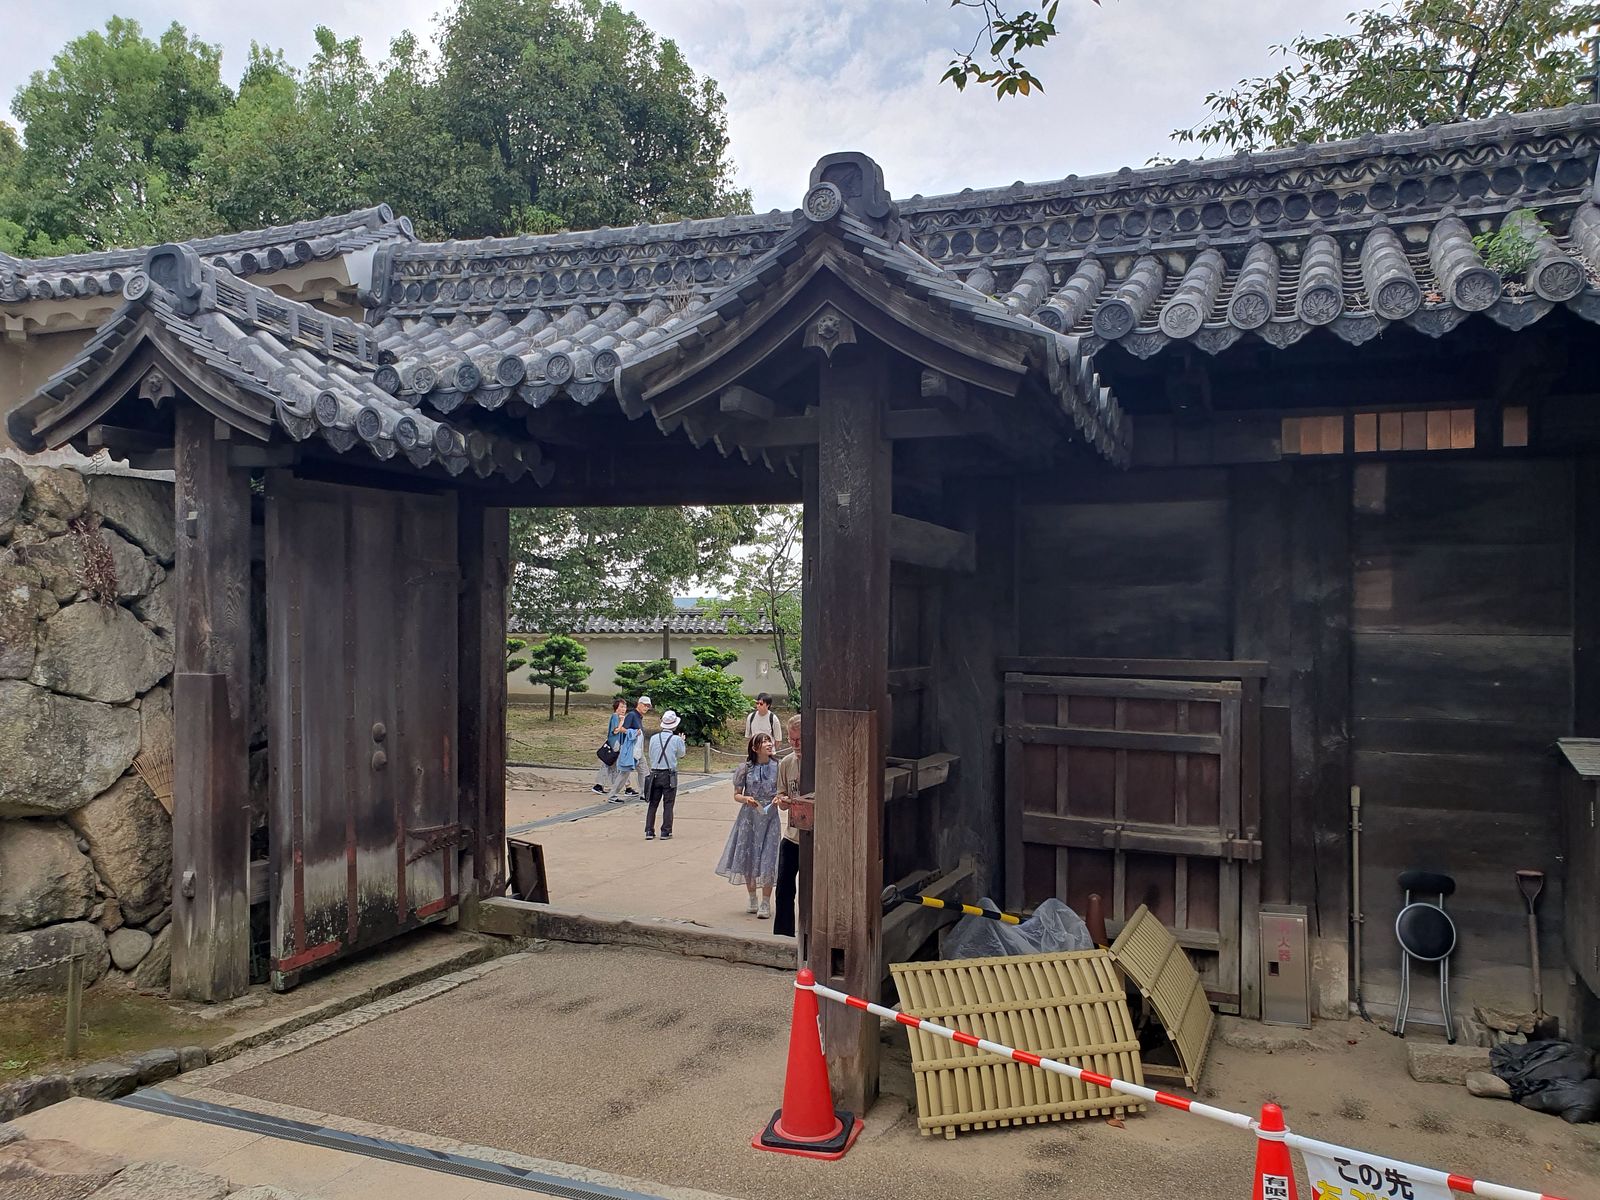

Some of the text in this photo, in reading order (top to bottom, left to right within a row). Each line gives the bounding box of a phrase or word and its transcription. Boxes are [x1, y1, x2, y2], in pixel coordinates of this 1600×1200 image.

[1264, 1175, 1287, 1200] 有限
[1334, 1157, 1414, 1200] この先
